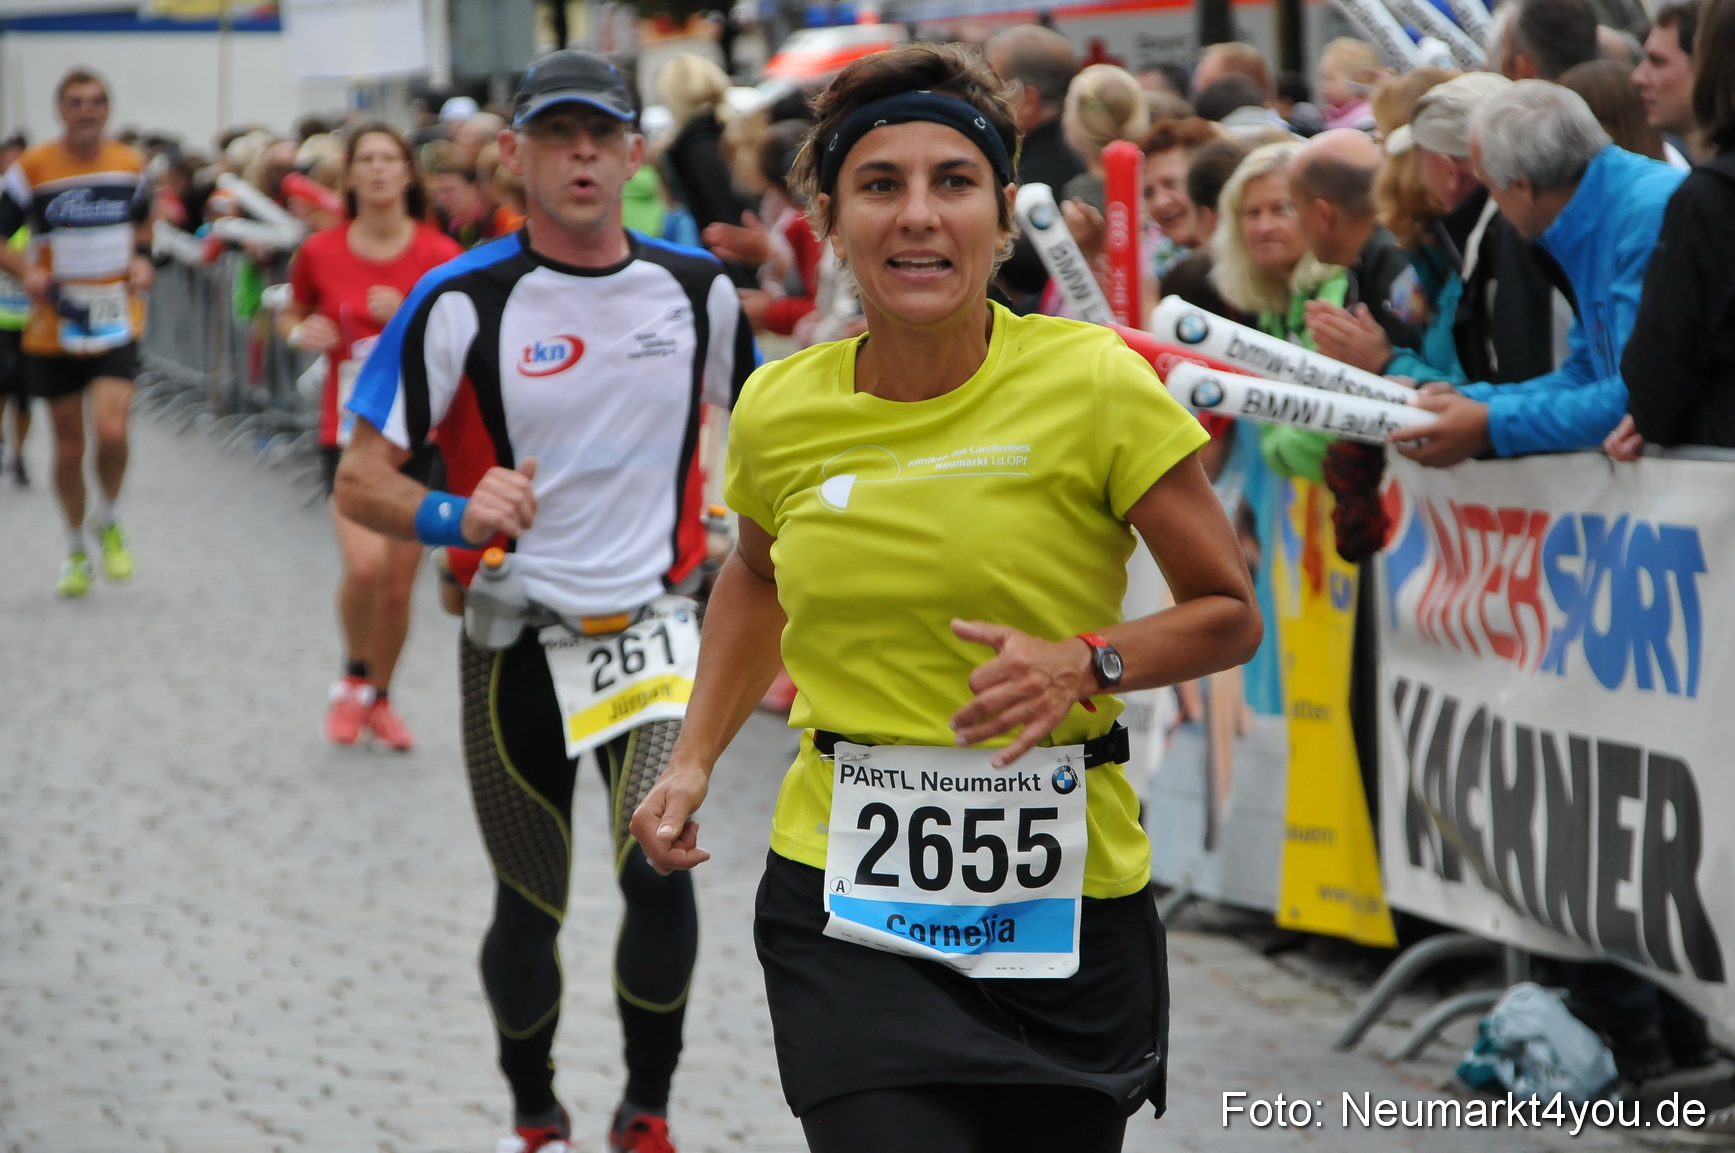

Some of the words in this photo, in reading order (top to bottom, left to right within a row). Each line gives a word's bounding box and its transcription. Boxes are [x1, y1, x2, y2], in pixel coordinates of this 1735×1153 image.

[1049, 242, 1093, 301] BMW
[522, 340, 567, 363] tkn
[1241, 388, 1320, 425] BMW
[907, 454, 949, 467] Kliniken
[951, 448, 967, 458] des
[970, 444, 1030, 454] Landkreises
[935, 458, 988, 470] Neumarkt
[587, 622, 675, 693] 261
[839, 764, 915, 791] PARTL
[921, 771, 1042, 792] Neumarkt
[854, 802, 1062, 893] 2655
[835, 879, 846, 894] A
[886, 913, 1016, 947] Cornelia
